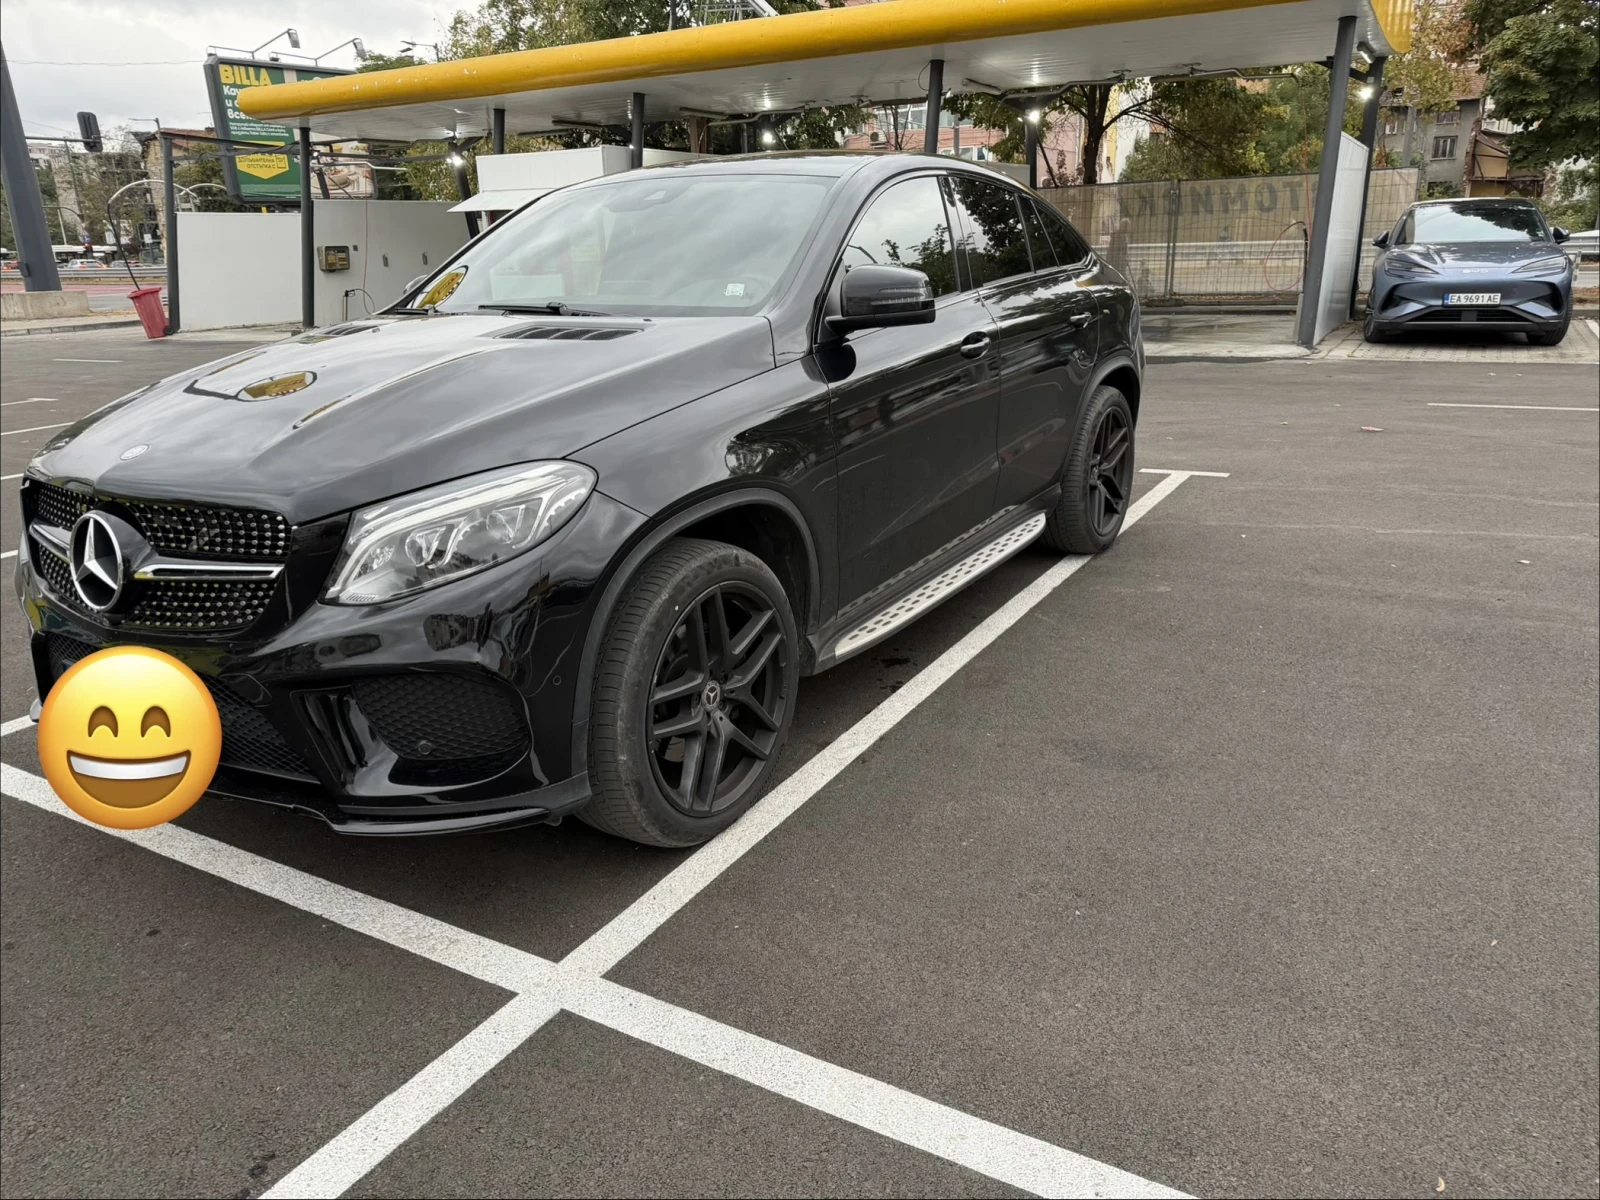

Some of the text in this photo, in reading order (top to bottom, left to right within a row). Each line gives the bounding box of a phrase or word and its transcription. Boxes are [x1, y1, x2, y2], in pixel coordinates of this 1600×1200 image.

[218, 64, 272, 86] BILLA
[1449, 294, 1499, 303] EA 9691 AE
